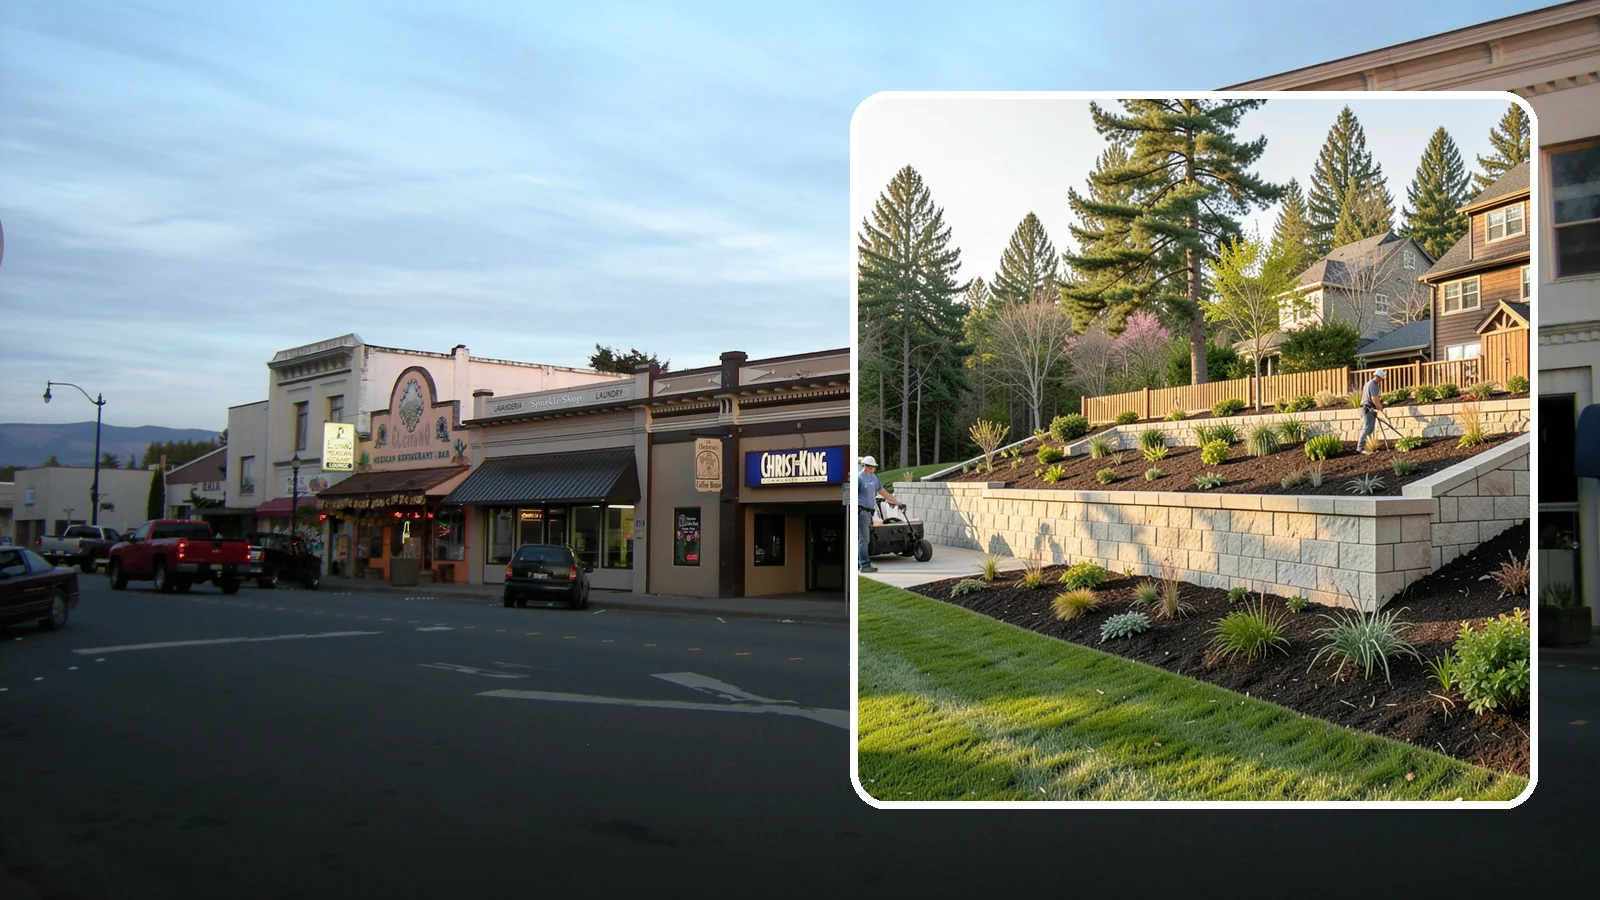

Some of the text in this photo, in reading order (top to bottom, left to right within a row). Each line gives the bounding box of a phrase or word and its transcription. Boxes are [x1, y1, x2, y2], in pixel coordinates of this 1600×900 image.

[562, 394, 582, 405] Shop
[595, 389, 624, 400] LAUNDRY
[493, 402, 523, 412] LAVANDERIA
[373, 450, 450, 464] MEXICAN RESTAURANT BAR
[761, 450, 827, 478] CHRIST KING
